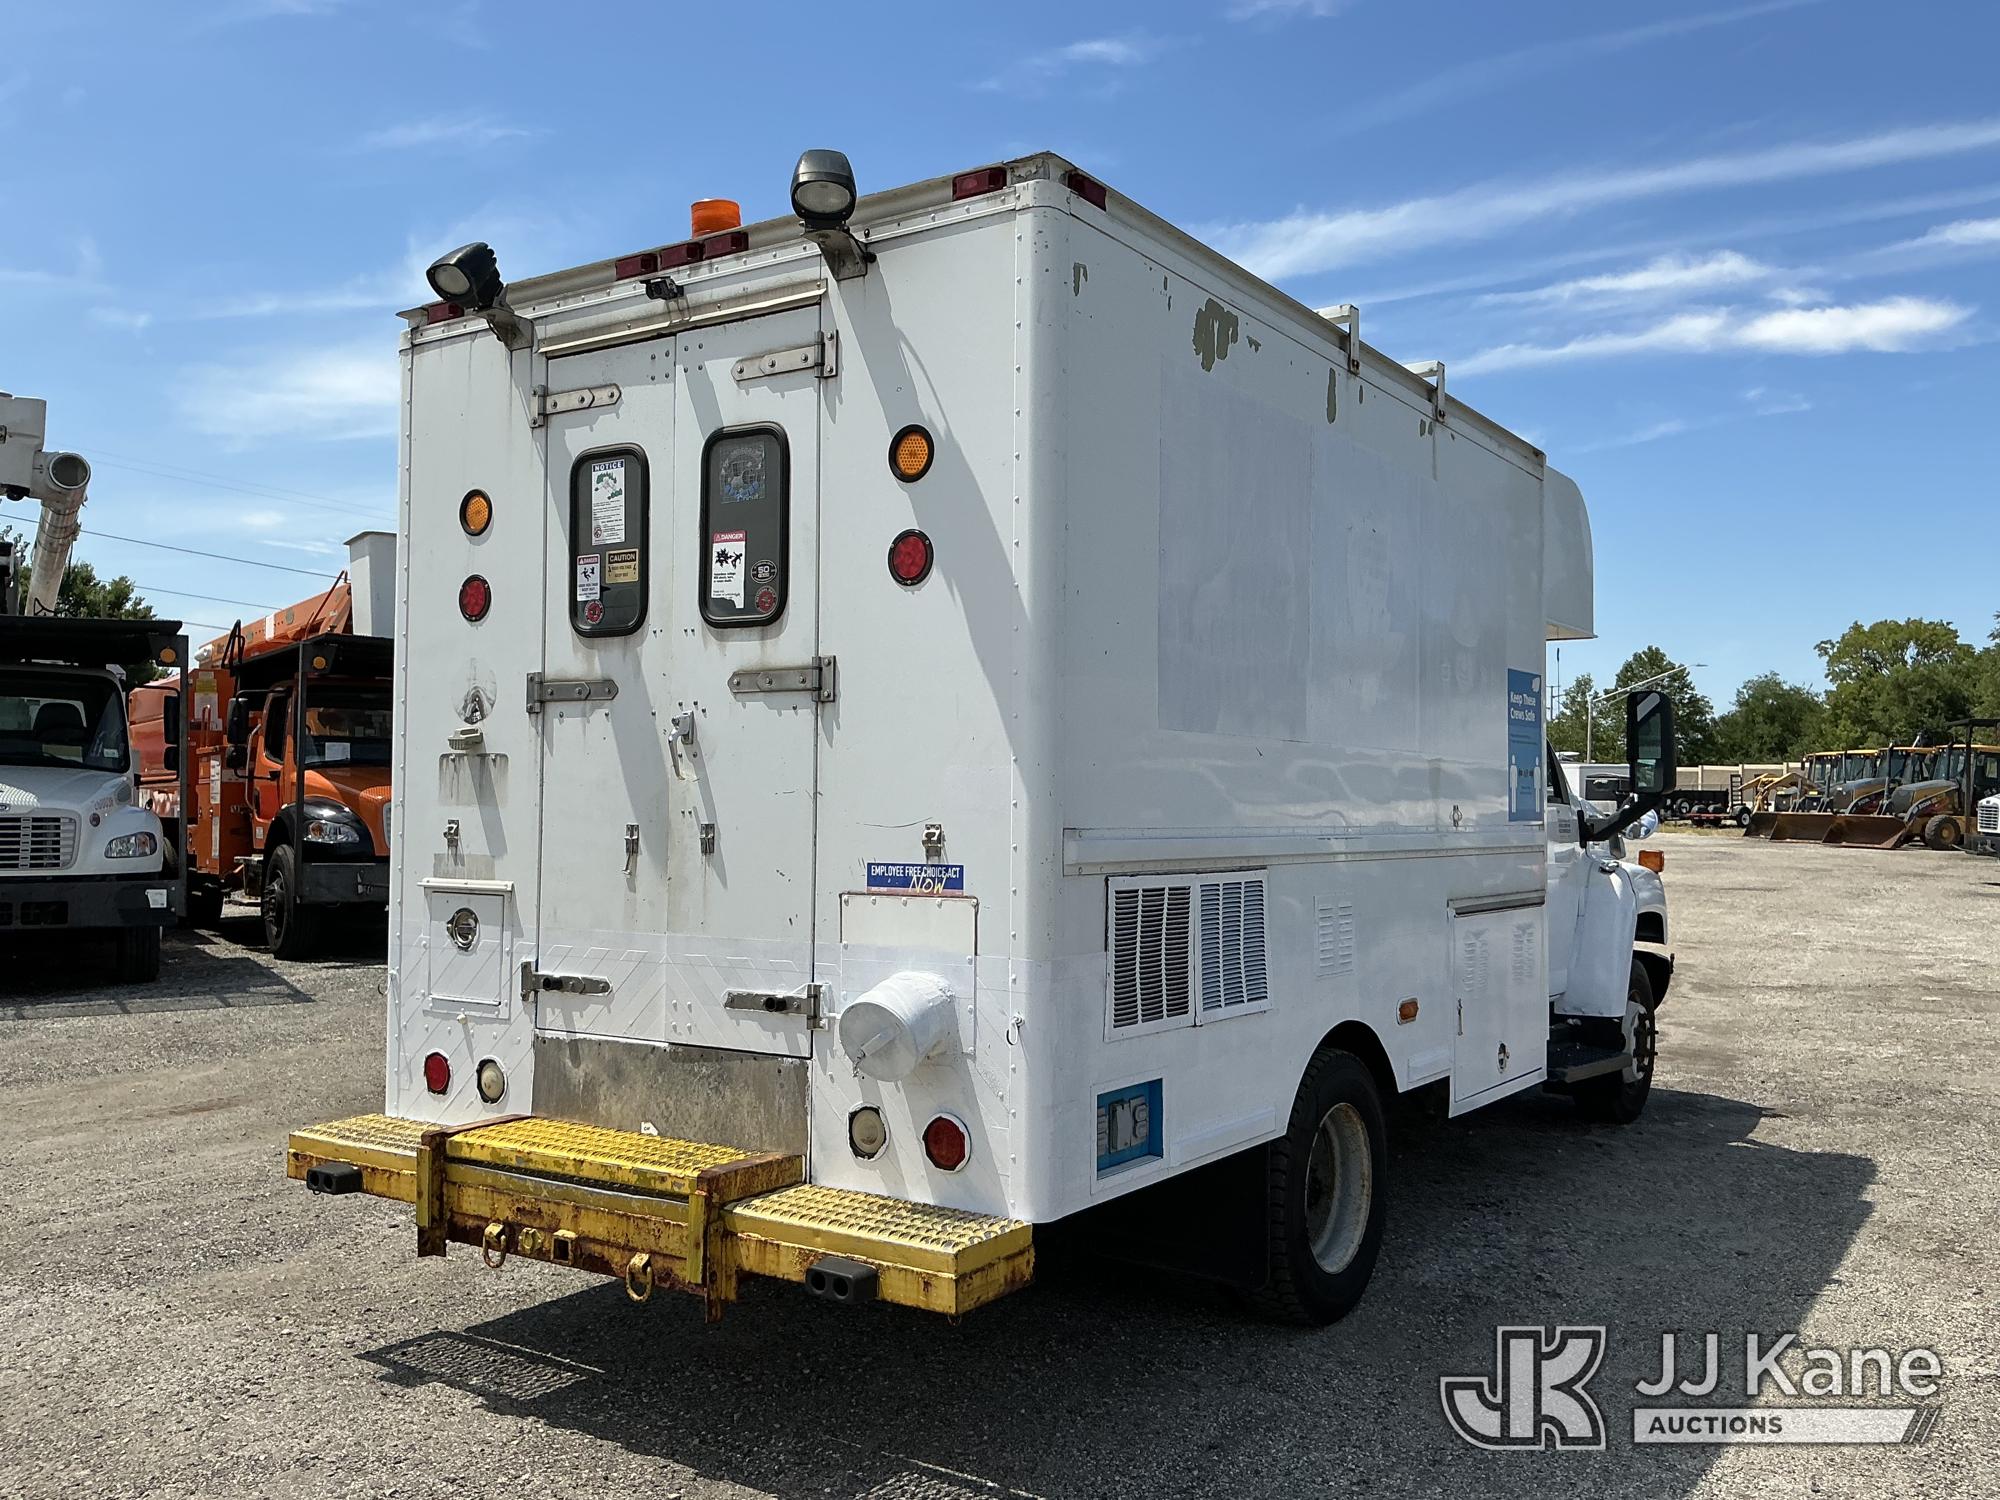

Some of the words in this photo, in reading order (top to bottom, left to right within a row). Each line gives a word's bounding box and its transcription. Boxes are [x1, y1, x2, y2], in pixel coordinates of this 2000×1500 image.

[595, 462, 621, 470] NOTICE
[609, 553, 635, 562] CAUTION
[1510, 691, 1523, 706] Keep
[1523, 694, 1536, 706] These
[1510, 707, 1525, 720] Crews
[1525, 709, 1536, 721] Safe
[871, 865, 904, 876] EMPLOYEE
[905, 866, 921, 877] FREE
[923, 867, 946, 878] CHOICE
[947, 867, 960, 878] ACT
